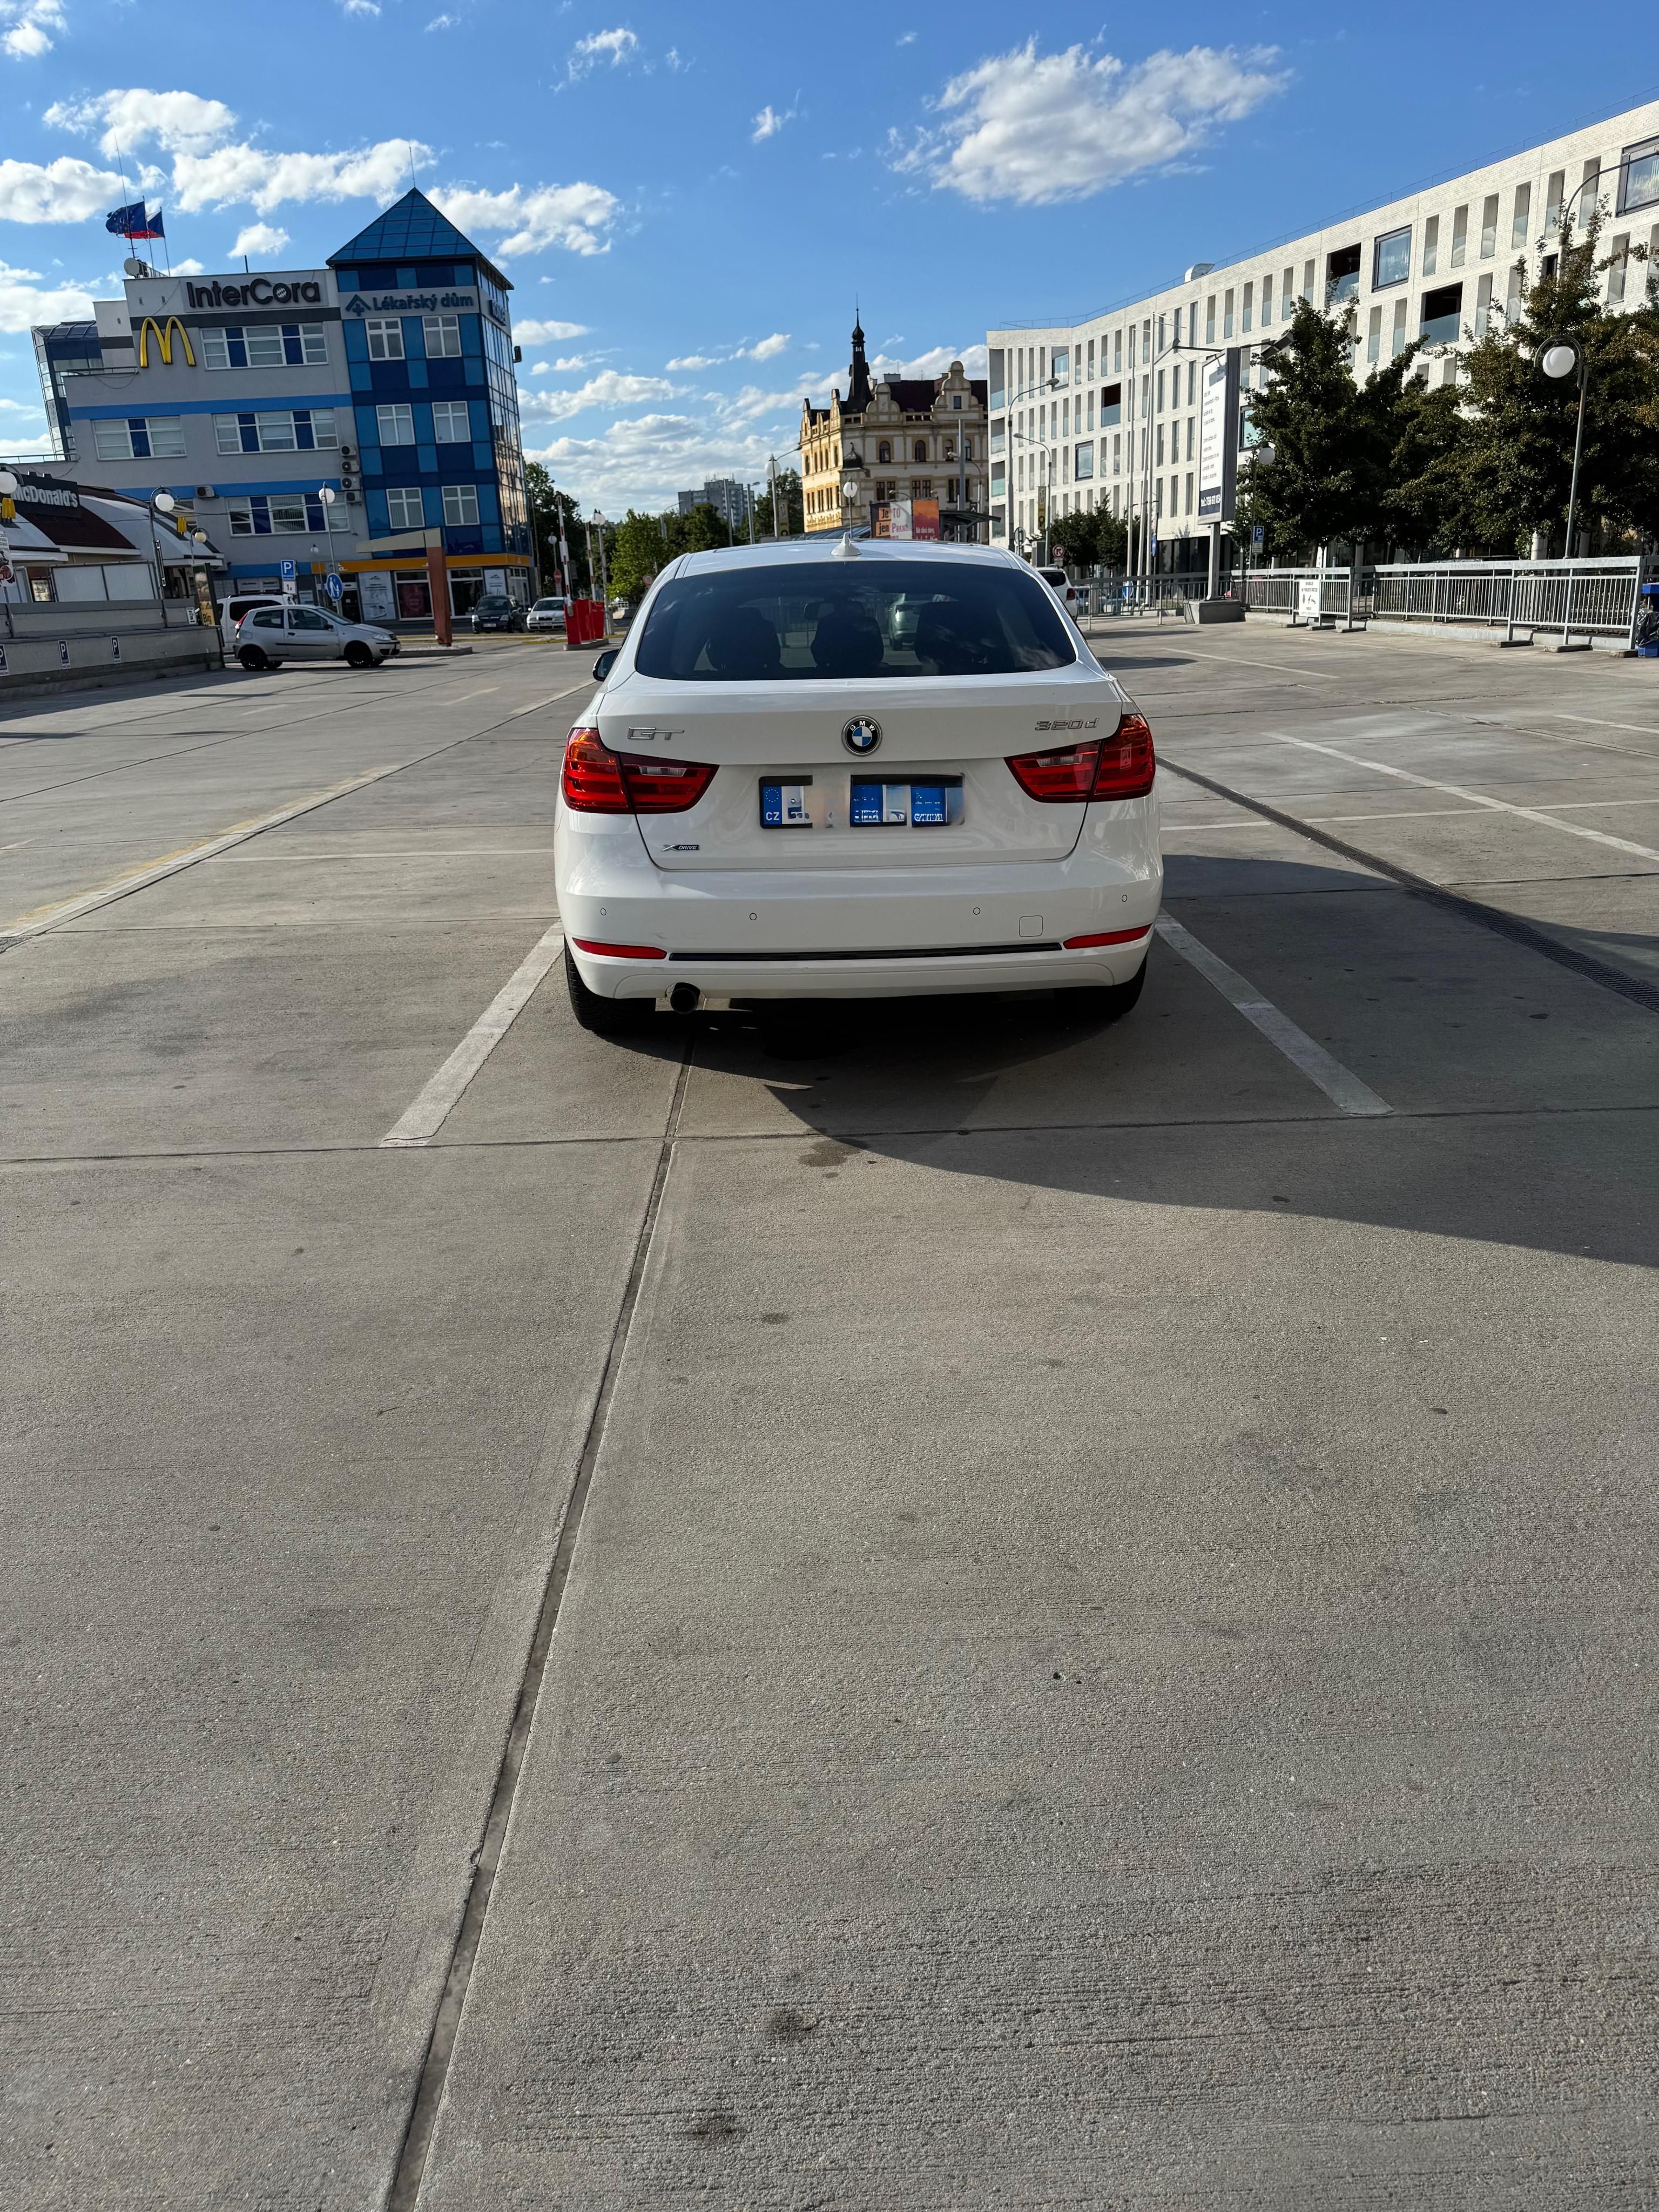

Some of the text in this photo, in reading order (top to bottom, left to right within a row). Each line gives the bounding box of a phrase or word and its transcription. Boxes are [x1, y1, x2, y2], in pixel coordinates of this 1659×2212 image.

[186, 278, 321, 308] InterCora
[373, 292, 474, 311] Lékařský dům
[11, 484, 78, 508] McDonald's
[881, 509, 889, 518] Je
[879, 523, 889, 535] jen
[1256, 528, 1262, 537] P
[284, 562, 292, 573] P
[849, 720, 876, 731] BMW
[1035, 718, 1100, 731] 320d
[627, 726, 684, 740] GT
[766, 812, 780, 821] CZ
